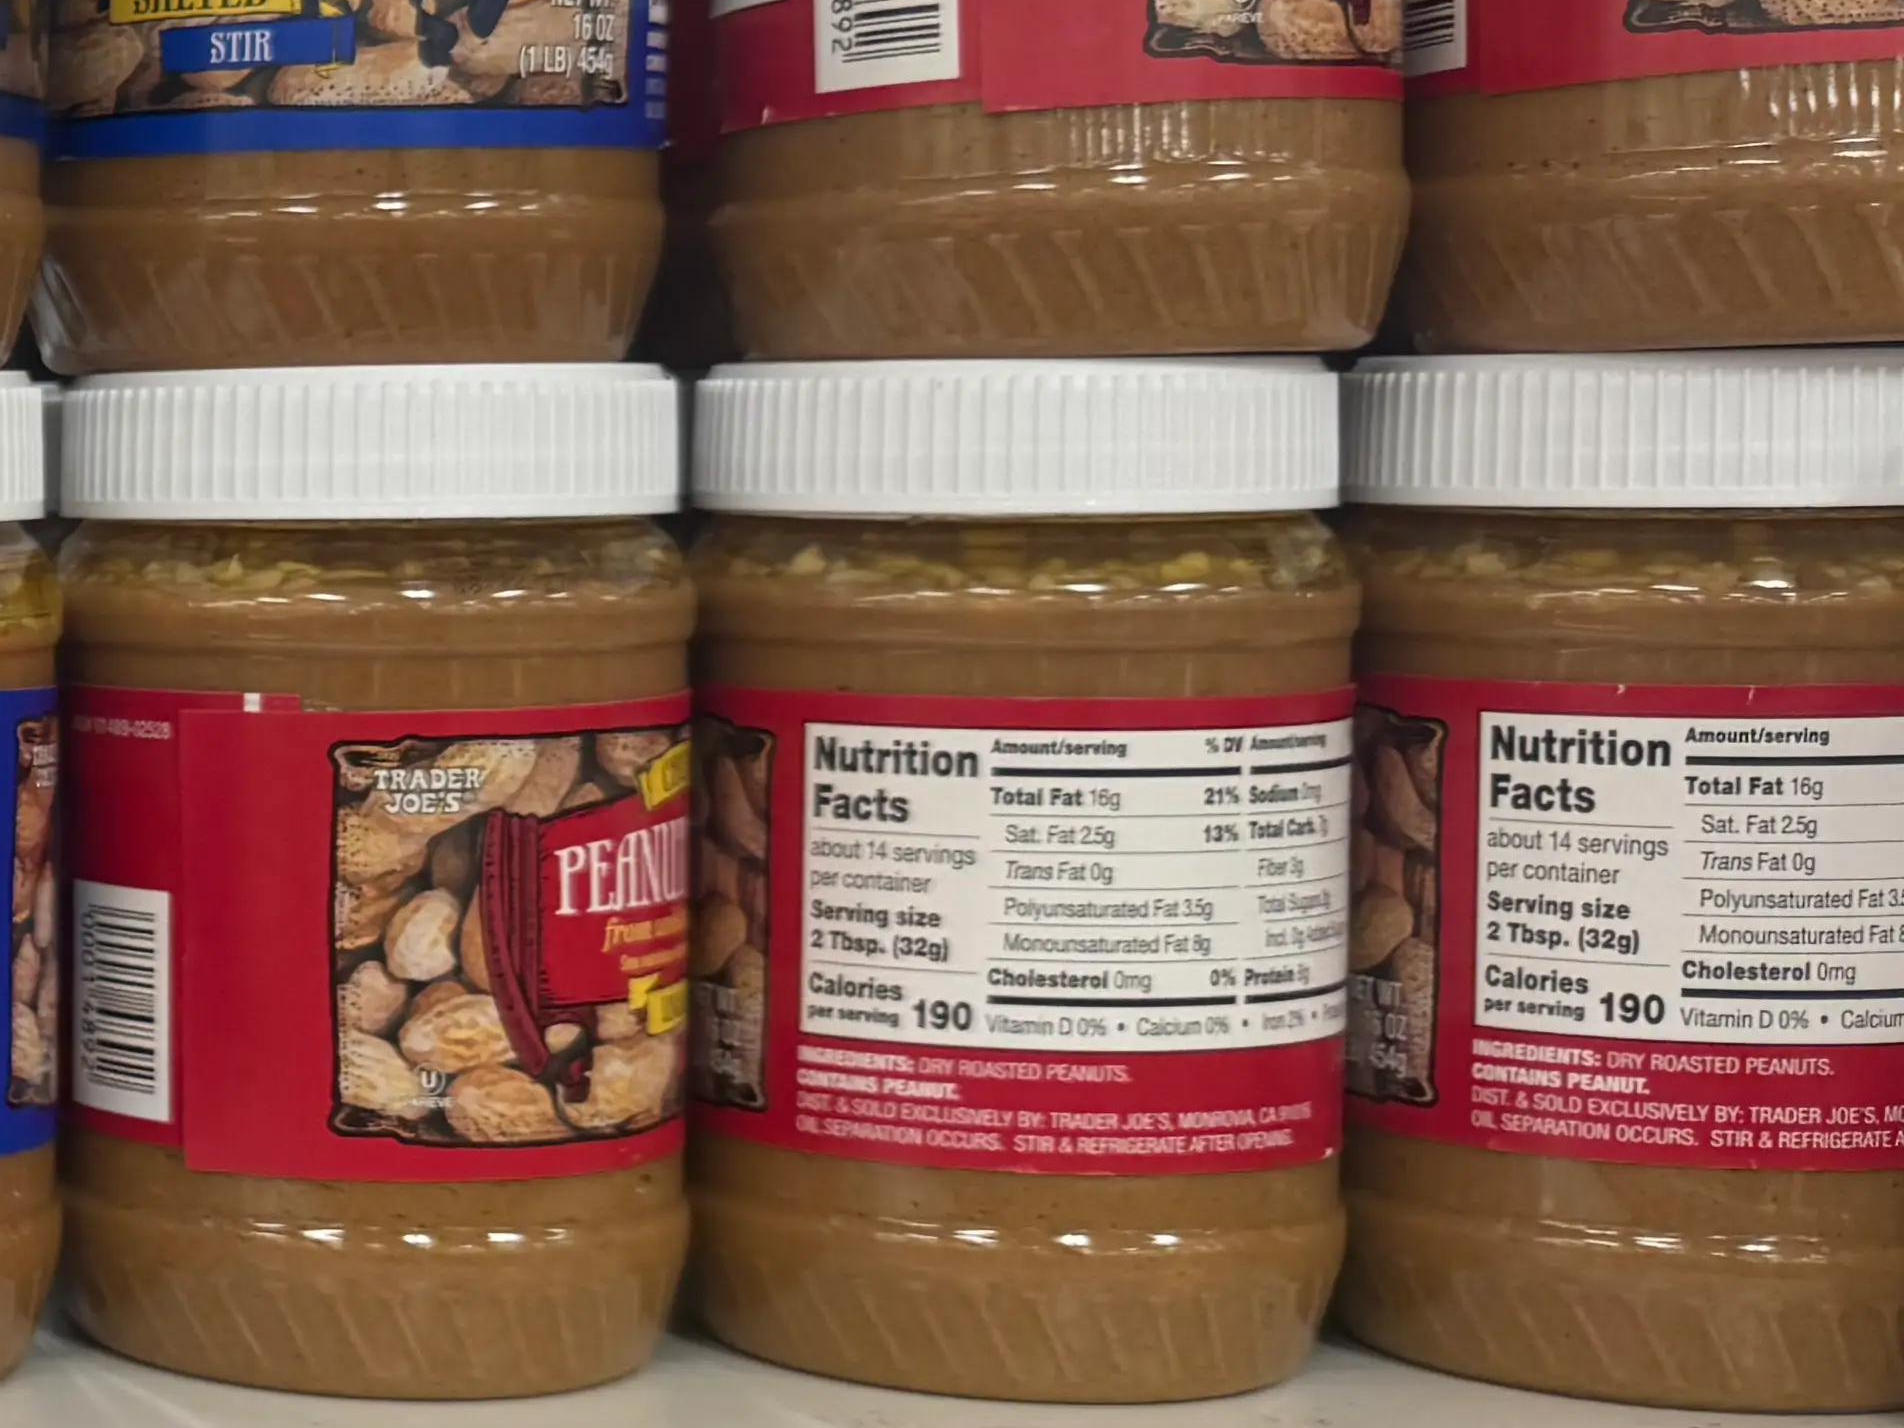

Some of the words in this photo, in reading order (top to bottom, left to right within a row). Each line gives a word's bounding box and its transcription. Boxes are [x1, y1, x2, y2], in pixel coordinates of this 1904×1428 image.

[572, 13, 589, 40] 16
[593, 14, 614, 41] OZ
[209, 29, 273, 62] STIR
[813, 735, 979, 779] Nutrition
[1490, 726, 1671, 767] Nutrition
[373, 768, 480, 790] TRADER
[1203, 786, 1239, 806] 21%
[1490, 775, 1596, 813] Facts
[812, 784, 909, 823] Facts
[1485, 964, 1589, 995] Calories
[1599, 993, 1665, 1025] 190
[912, 1000, 972, 1031] 190
